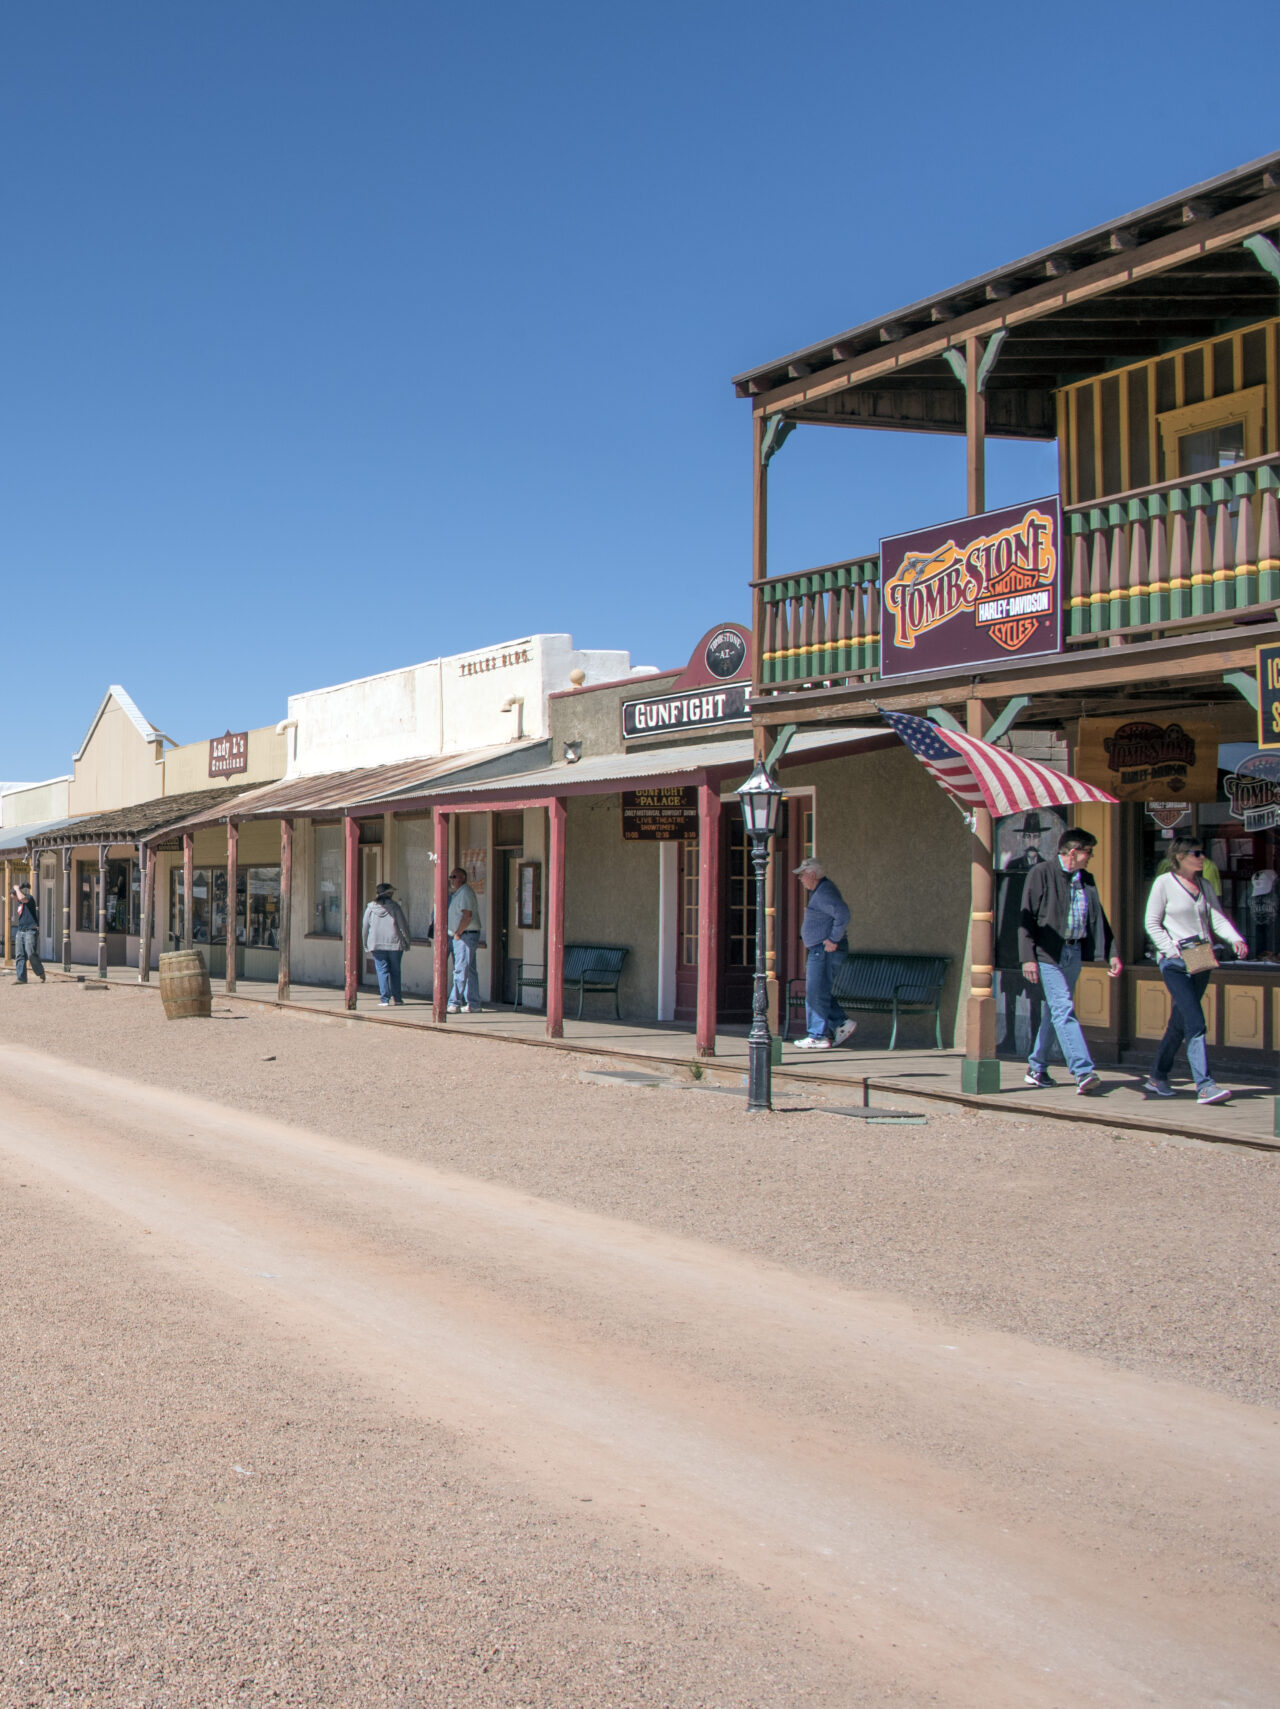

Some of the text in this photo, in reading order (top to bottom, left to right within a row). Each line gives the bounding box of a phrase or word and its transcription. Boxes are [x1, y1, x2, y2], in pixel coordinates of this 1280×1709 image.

[889, 519, 1050, 643] TOMBSTONE
[994, 571, 1033, 594] MOTOR
[978, 591, 1049, 622] HARLEY-DAVIDSON
[994, 619, 1033, 645] CYCLES
[460, 656, 496, 676] TELLES
[634, 694, 726, 729] GUNFIGHT
[213, 736, 244, 759] Lady L's
[211, 757, 244, 771] Creations
[640, 796, 681, 806] PALACE
